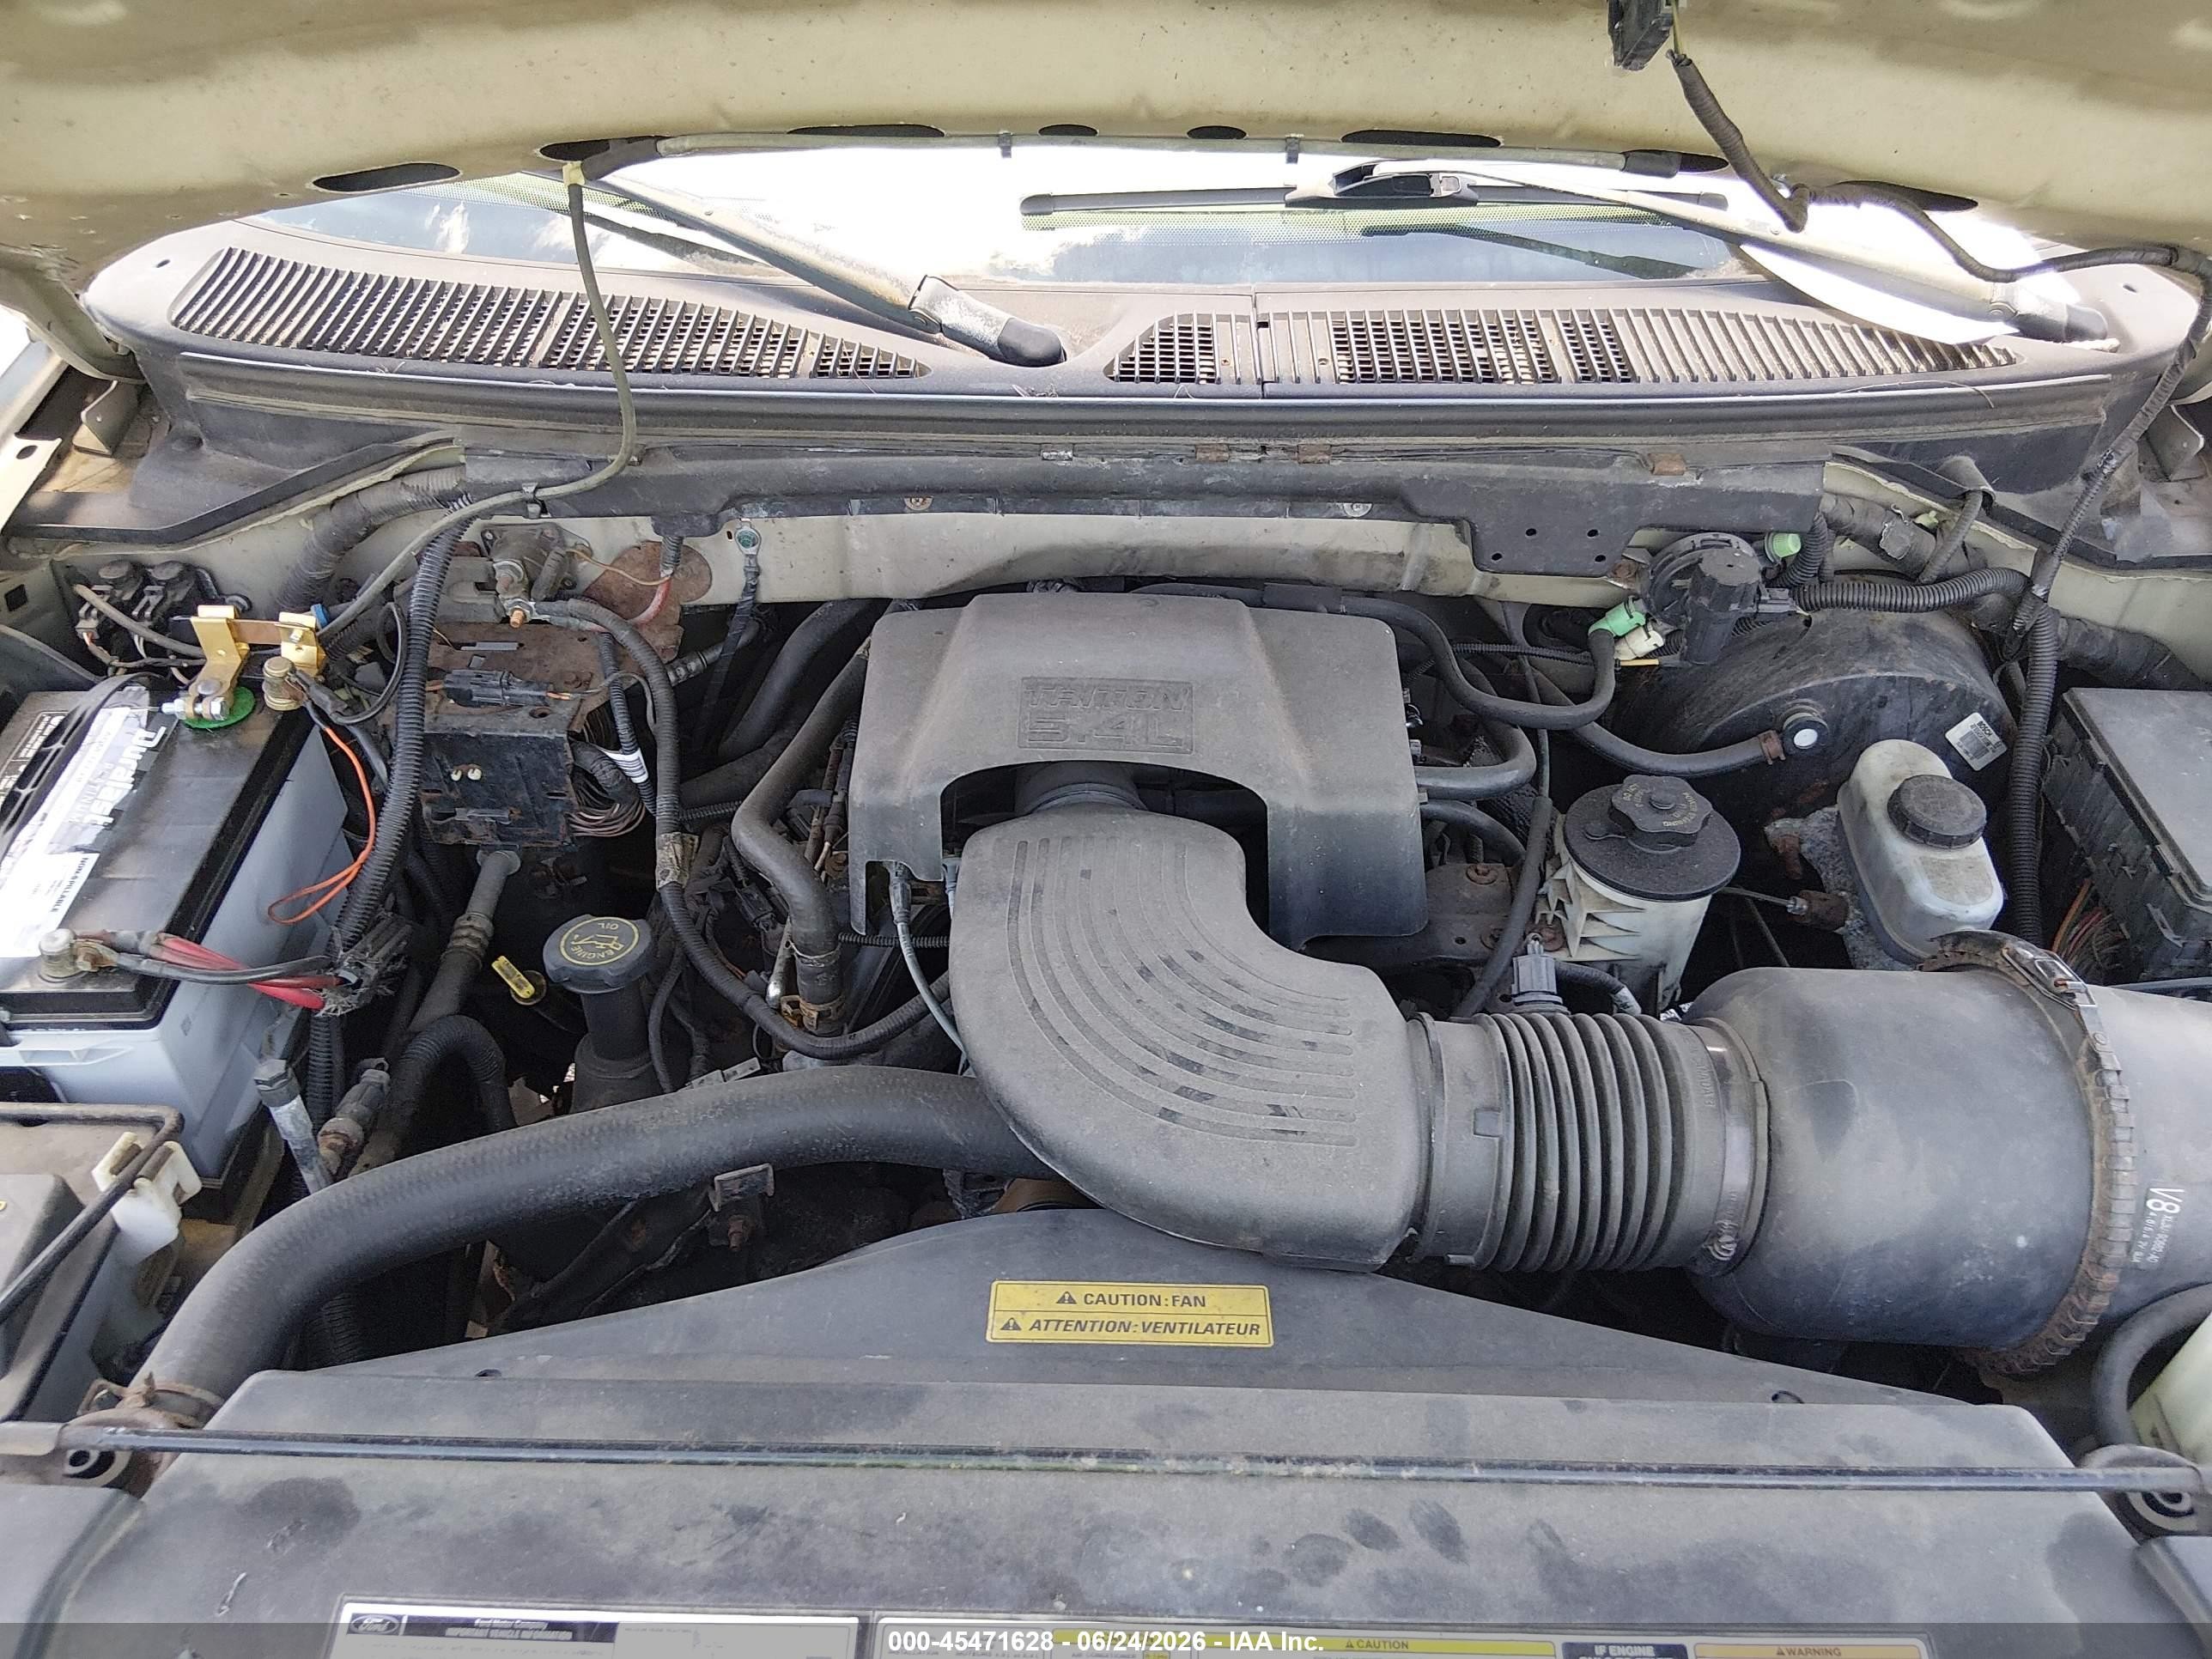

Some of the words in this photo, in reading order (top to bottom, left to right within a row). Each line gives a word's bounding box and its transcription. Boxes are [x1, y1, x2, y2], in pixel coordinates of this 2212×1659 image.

[83, 726, 167, 826] Duralast
[598, 921, 619, 930] OIL
[2146, 1188, 2185, 1213] V8
[1356, 1638, 1409, 1650] CAUTION
[1595, 1644, 1607, 1656] IF
[1608, 1645, 1656, 1656] ENGINE
[1786, 1648, 1842, 1656] WARNING
